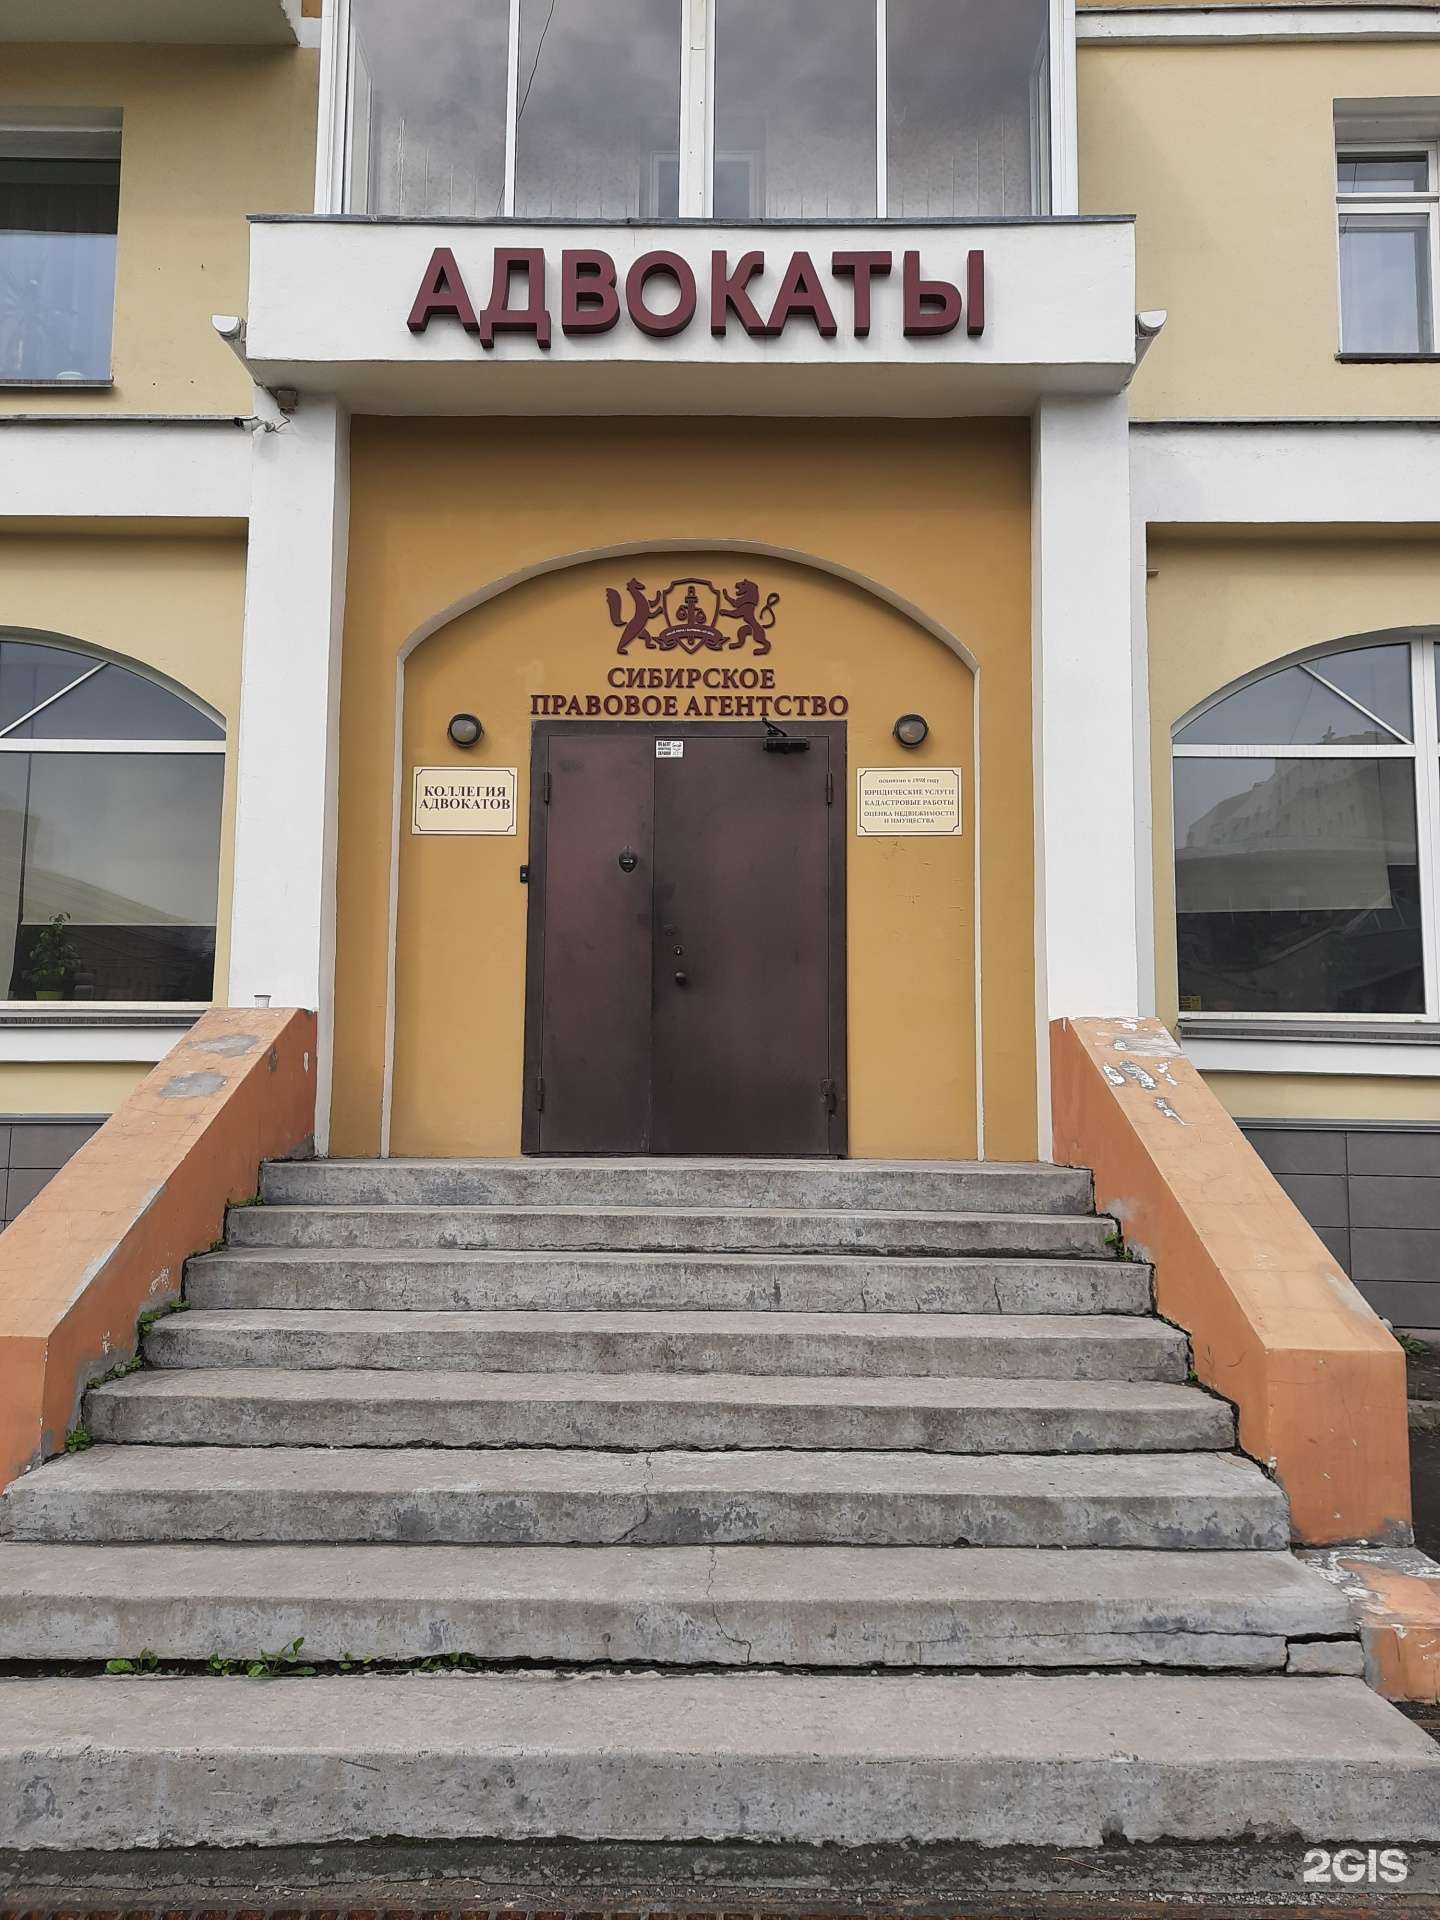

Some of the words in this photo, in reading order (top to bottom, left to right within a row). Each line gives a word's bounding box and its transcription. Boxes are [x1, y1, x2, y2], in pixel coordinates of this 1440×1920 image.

[407, 247, 985, 350] АДВОКАТЫ
[607, 667, 776, 689] СИБИРСКОЕ
[531, 694, 678, 717] ПРАВОВОЕ
[683, 694, 849, 717] АГЕНТСТВО
[424, 786, 506, 797] КОЛЛЕГИЯ
[419, 798, 510, 811] АДВОКАТОВ
